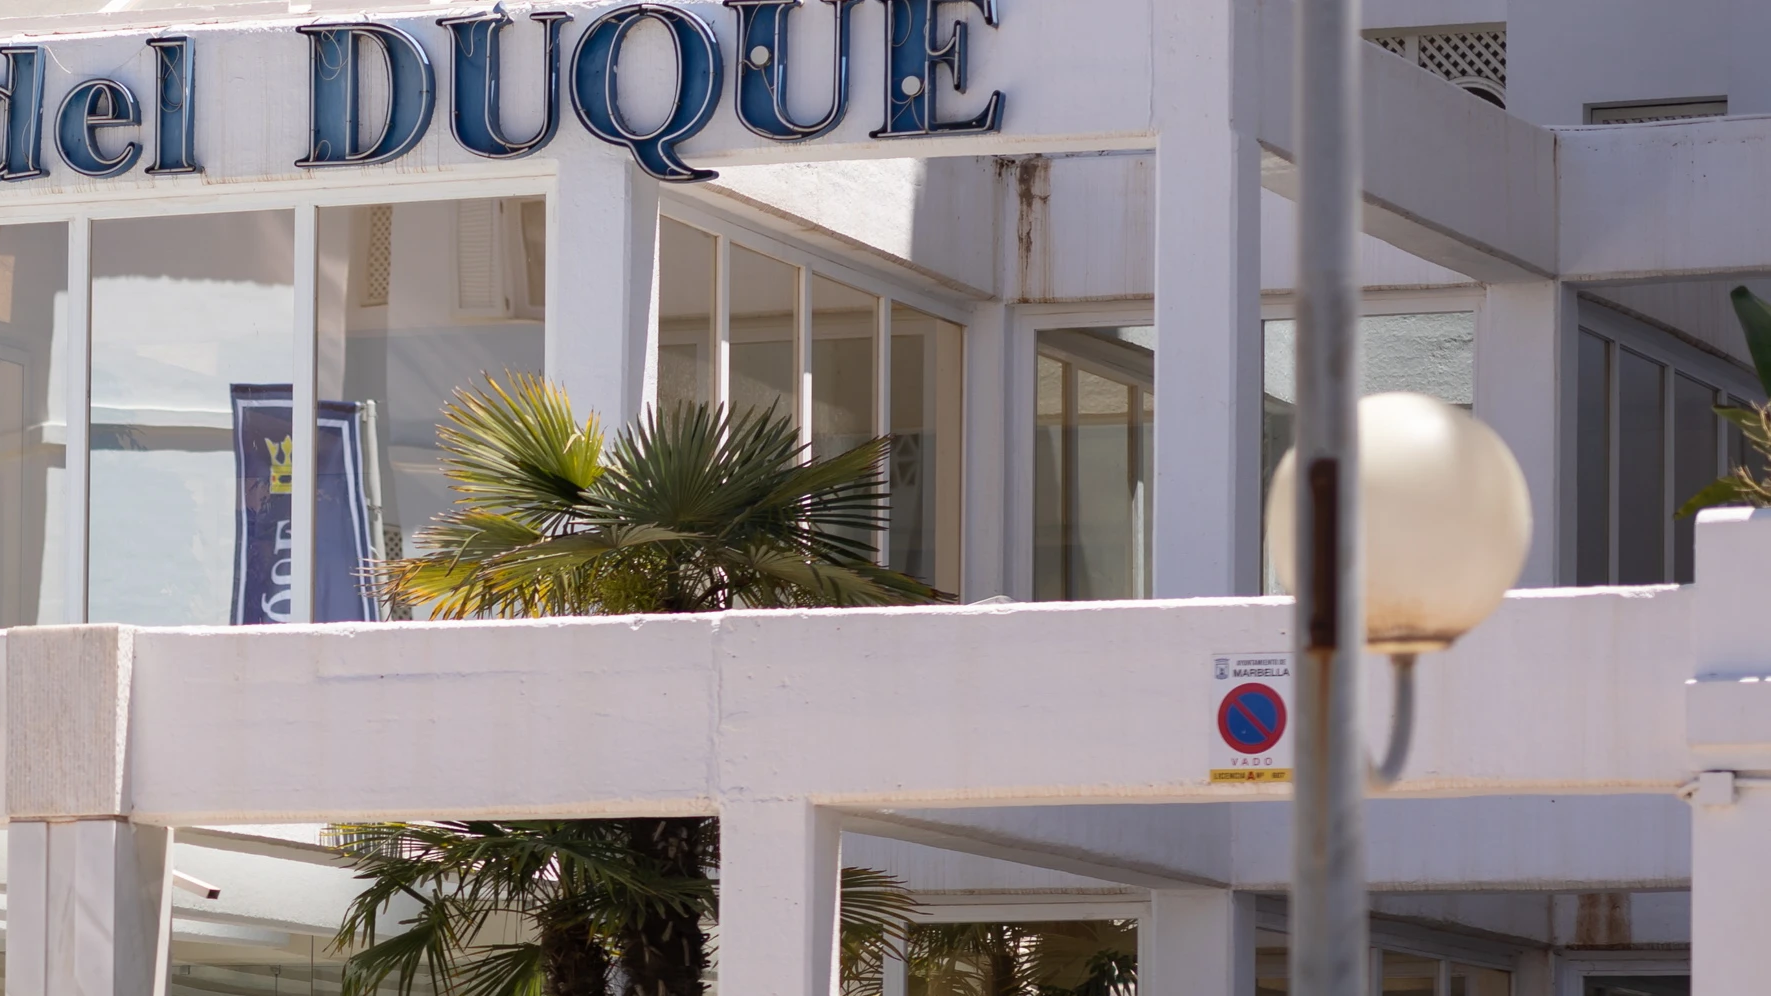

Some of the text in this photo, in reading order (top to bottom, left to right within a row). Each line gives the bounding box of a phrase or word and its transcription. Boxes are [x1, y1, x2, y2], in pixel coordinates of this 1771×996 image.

[295, 0, 1006, 182] DUQUE
[1233, 668, 1291, 678] MARBELLA
[1231, 757, 1273, 766] VADO
